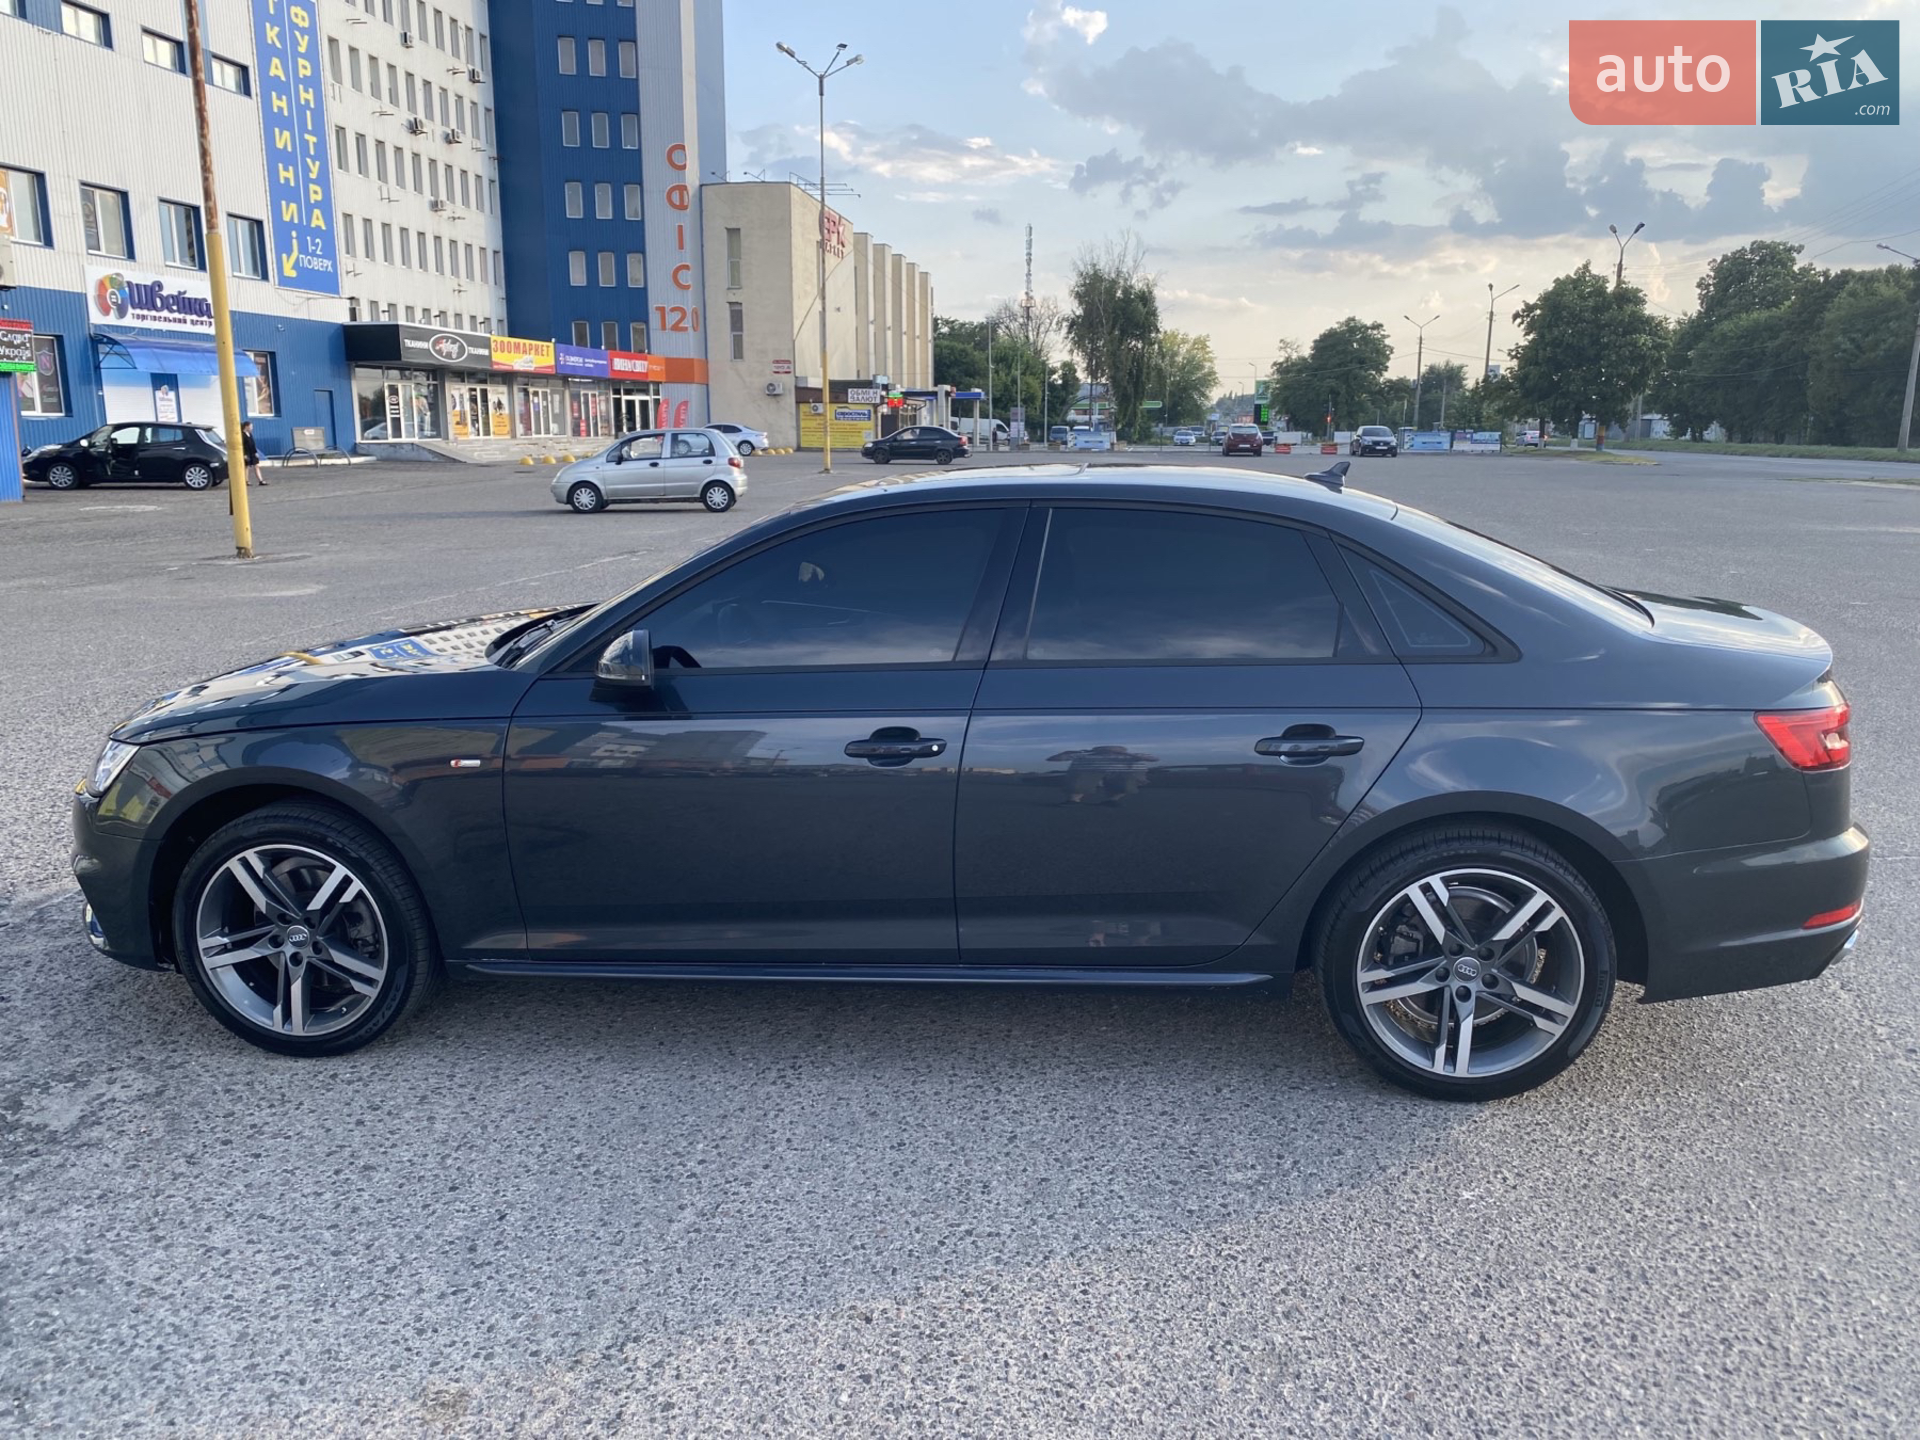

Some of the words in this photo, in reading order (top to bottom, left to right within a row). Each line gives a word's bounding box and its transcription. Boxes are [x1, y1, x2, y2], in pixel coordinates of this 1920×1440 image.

[289, 5, 326, 230] ФУРНІТУРА
[306, 236, 323, 255] 1-2
[299, 254, 333, 272] ПОВЕРХ
[654, 305, 700, 333] 120
[492, 339, 551, 357] ЗООМАРКЕТ
